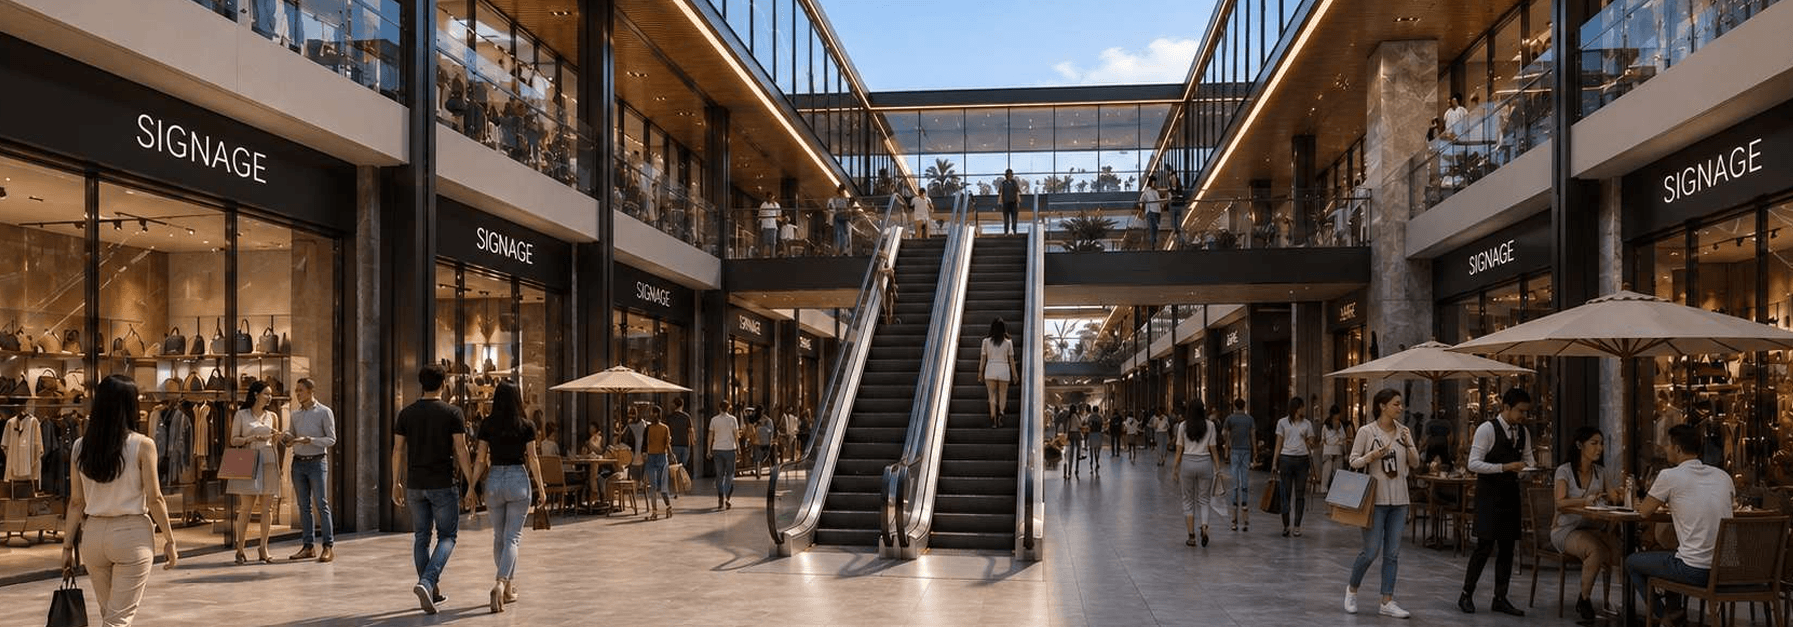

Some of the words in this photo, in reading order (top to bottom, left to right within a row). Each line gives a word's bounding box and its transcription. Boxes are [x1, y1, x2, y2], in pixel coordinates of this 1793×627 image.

[136, 114, 267, 184] SIGNAGE
[1663, 138, 1763, 203] SIGNAGE
[476, 227, 534, 265] SIGNAGE
[1468, 239, 1515, 276] SIGNAGE
[636, 281, 670, 307] SIGNAGE
